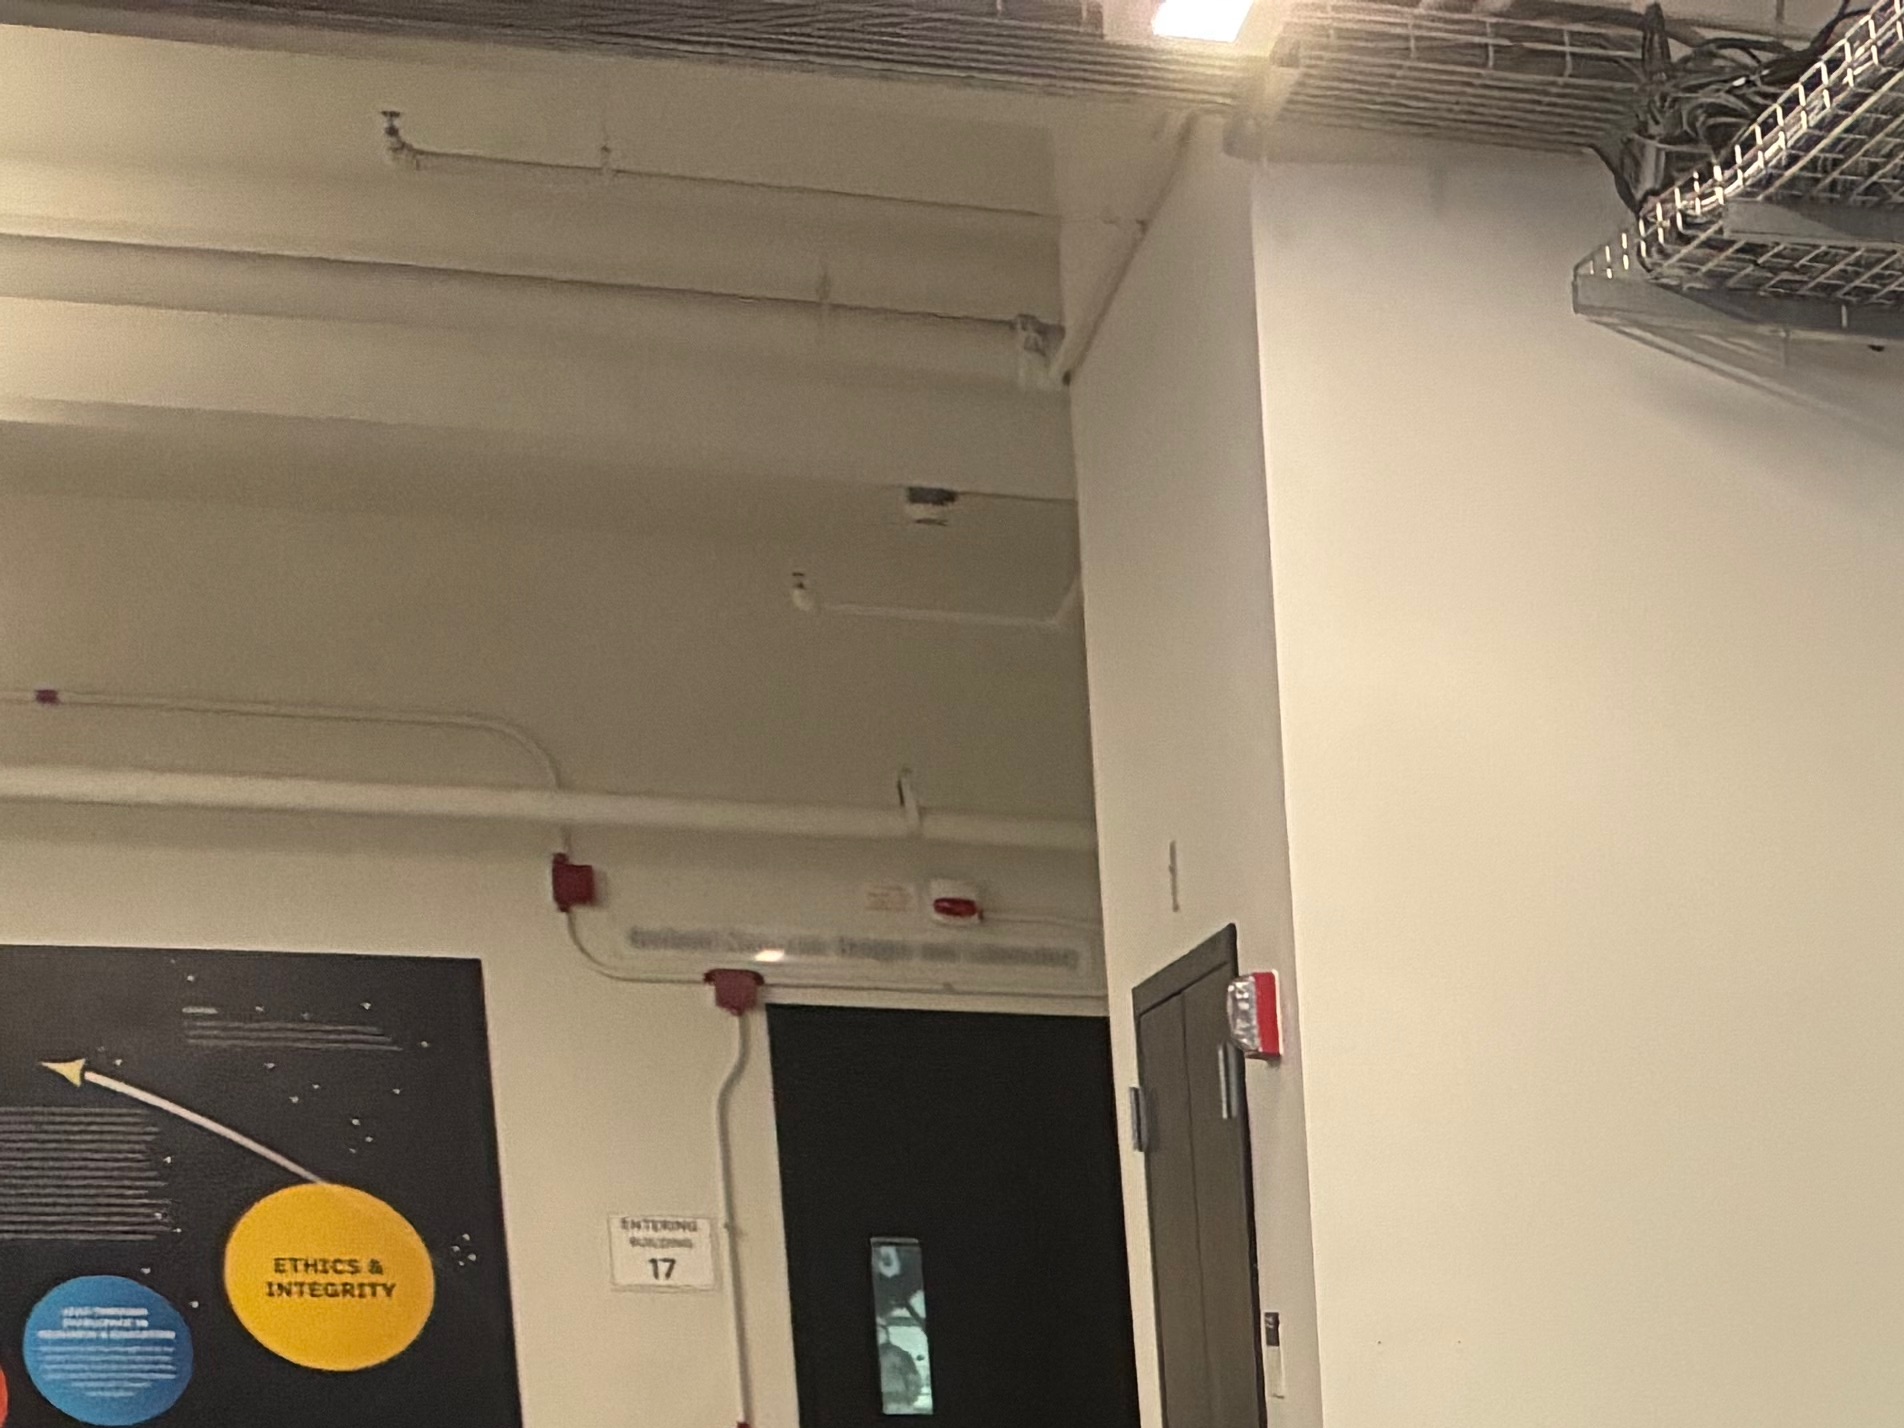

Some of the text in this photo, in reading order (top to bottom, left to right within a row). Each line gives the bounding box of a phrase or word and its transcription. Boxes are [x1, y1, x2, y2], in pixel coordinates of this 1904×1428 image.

[620, 1218, 697, 1232] ENTERING
[273, 1257, 384, 1275] ETHICS &
[648, 1257, 676, 1281] 17
[266, 1281, 397, 1298] INTEGRITY
